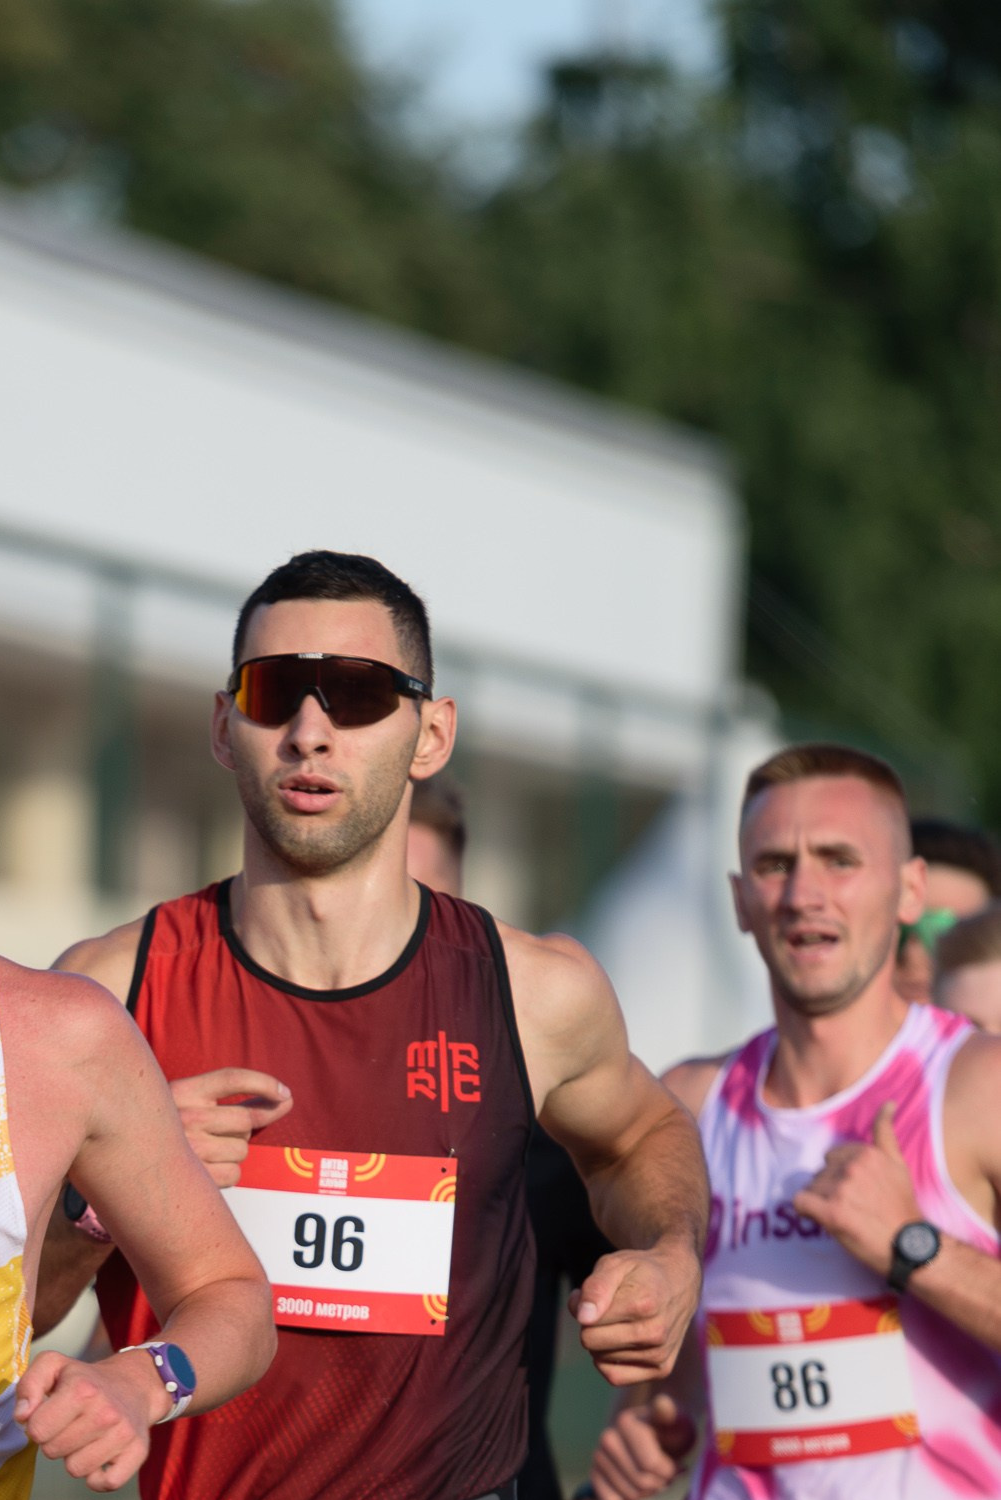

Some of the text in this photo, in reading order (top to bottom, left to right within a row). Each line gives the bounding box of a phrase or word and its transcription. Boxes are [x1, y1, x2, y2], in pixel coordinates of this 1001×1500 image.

[293, 1212, 365, 1272] 96
[277, 1297, 370, 1322] 3000 метров
[770, 1359, 831, 1412] 86
